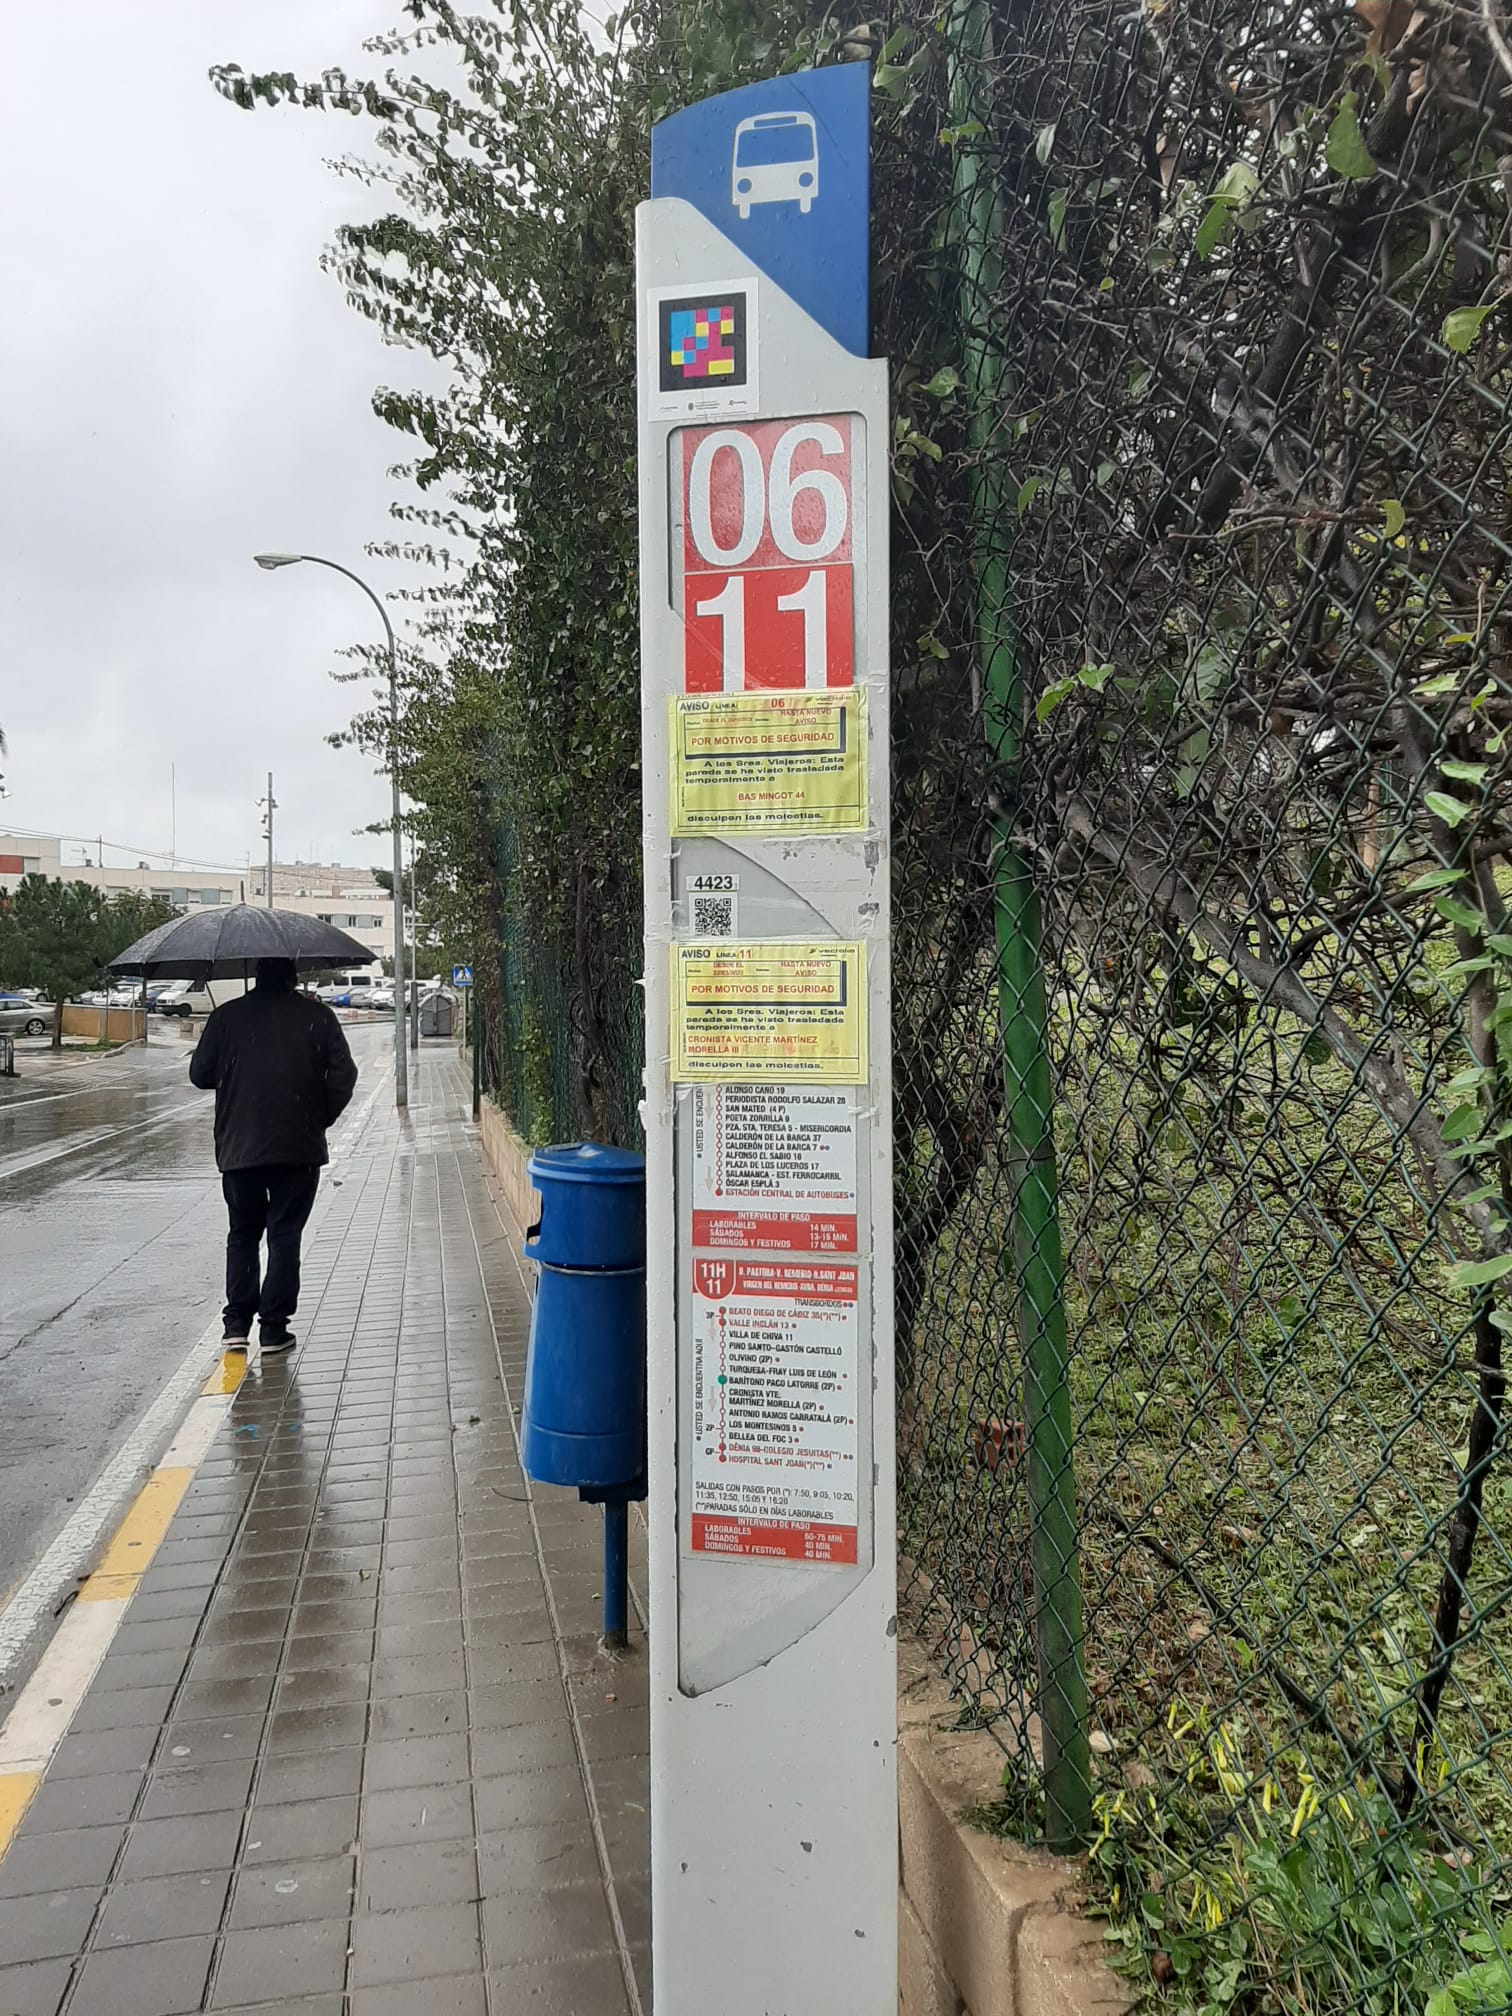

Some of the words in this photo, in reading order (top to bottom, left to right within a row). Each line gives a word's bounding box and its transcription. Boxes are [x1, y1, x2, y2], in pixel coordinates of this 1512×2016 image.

[689, 422, 847, 566] 06
[696, 569, 827, 691] 11
[680, 701, 709, 711] AVISO
[771, 698, 784, 708] 06
[714, 736, 758, 745] MOTIVOS
[761, 735, 774, 743] DE
[777, 733, 834, 742] SEGURIDAD
[787, 765, 844, 773] trasladada
[686, 776, 765, 784] temporalmente
[758, 792, 793, 800] MINGOT
[687, 814, 741, 823] disculpen
[695, 876, 733, 890] 4423
[681, 950, 710, 958] AVISO
[739, 950, 751, 958] 11
[692, 985, 712, 993] POR
[714, 985, 758, 993] MOTIVOS
[762, 985, 774, 993] DE
[777, 985, 834, 993] SEGURIDAD
[773, 1034, 818, 1043] MARTÍNEZ
[688, 1061, 742, 1069] disculpen
[768, 1096, 800, 1104] RODOLFO
[726, 1114, 747, 1122] POETA
[800, 1125, 851, 1133] MISERICORDIA
[726, 1133, 762, 1141] CALDERÓN
[726, 1142, 762, 1150] CALDERÓN
[726, 1179, 749, 1187] ÓSCAR
[726, 1189, 759, 1197] ESTACIÓN
[808, 1191, 848, 1199] AUTOBUSES
[737, 1212, 777, 1220] INTERVALO
[710, 1221, 756, 1229] LABORABLES
[710, 1238, 748, 1246] DOMINGOS
[701, 1263, 726, 1278] 11H
[707, 1279, 720, 1294] 11
[729, 1307, 751, 1315] BEATO
[754, 1308, 775, 1316] DIEGO
[729, 1319, 750, 1327] VALLE
[807, 1369, 816, 1377] DE
[729, 1376, 764, 1385] BARÍTONO
[787, 1380, 818, 1389] LATORRE
[729, 1389, 763, 1397] CRONISTA
[767, 1400, 800, 1408] MORELLA
[729, 1410, 759, 1418] ANTONIO
[762, 1411, 787, 1419] RAMOS
[745, 1422, 790, 1431] MONTESINOS
[729, 1456, 762, 1464] HOSPITAL
[765, 1457, 782, 1466] SANT
[696, 1481, 724, 1490] SALIDAS
[726, 1484, 740, 1492] CON
[742, 1485, 764, 1493] PASOS
[767, 1487, 780, 1495] POR
[789, 1509, 833, 1519] LABORABLES
[737, 1518, 777, 1528] INTERVALO
[779, 1520, 789, 1528] DE
[791, 1521, 810, 1529] PASO
[704, 1525, 751, 1535] LABORABLES
[704, 1542, 744, 1552] DOMINGOS
[752, 1546, 785, 1555] FESTIVOS
